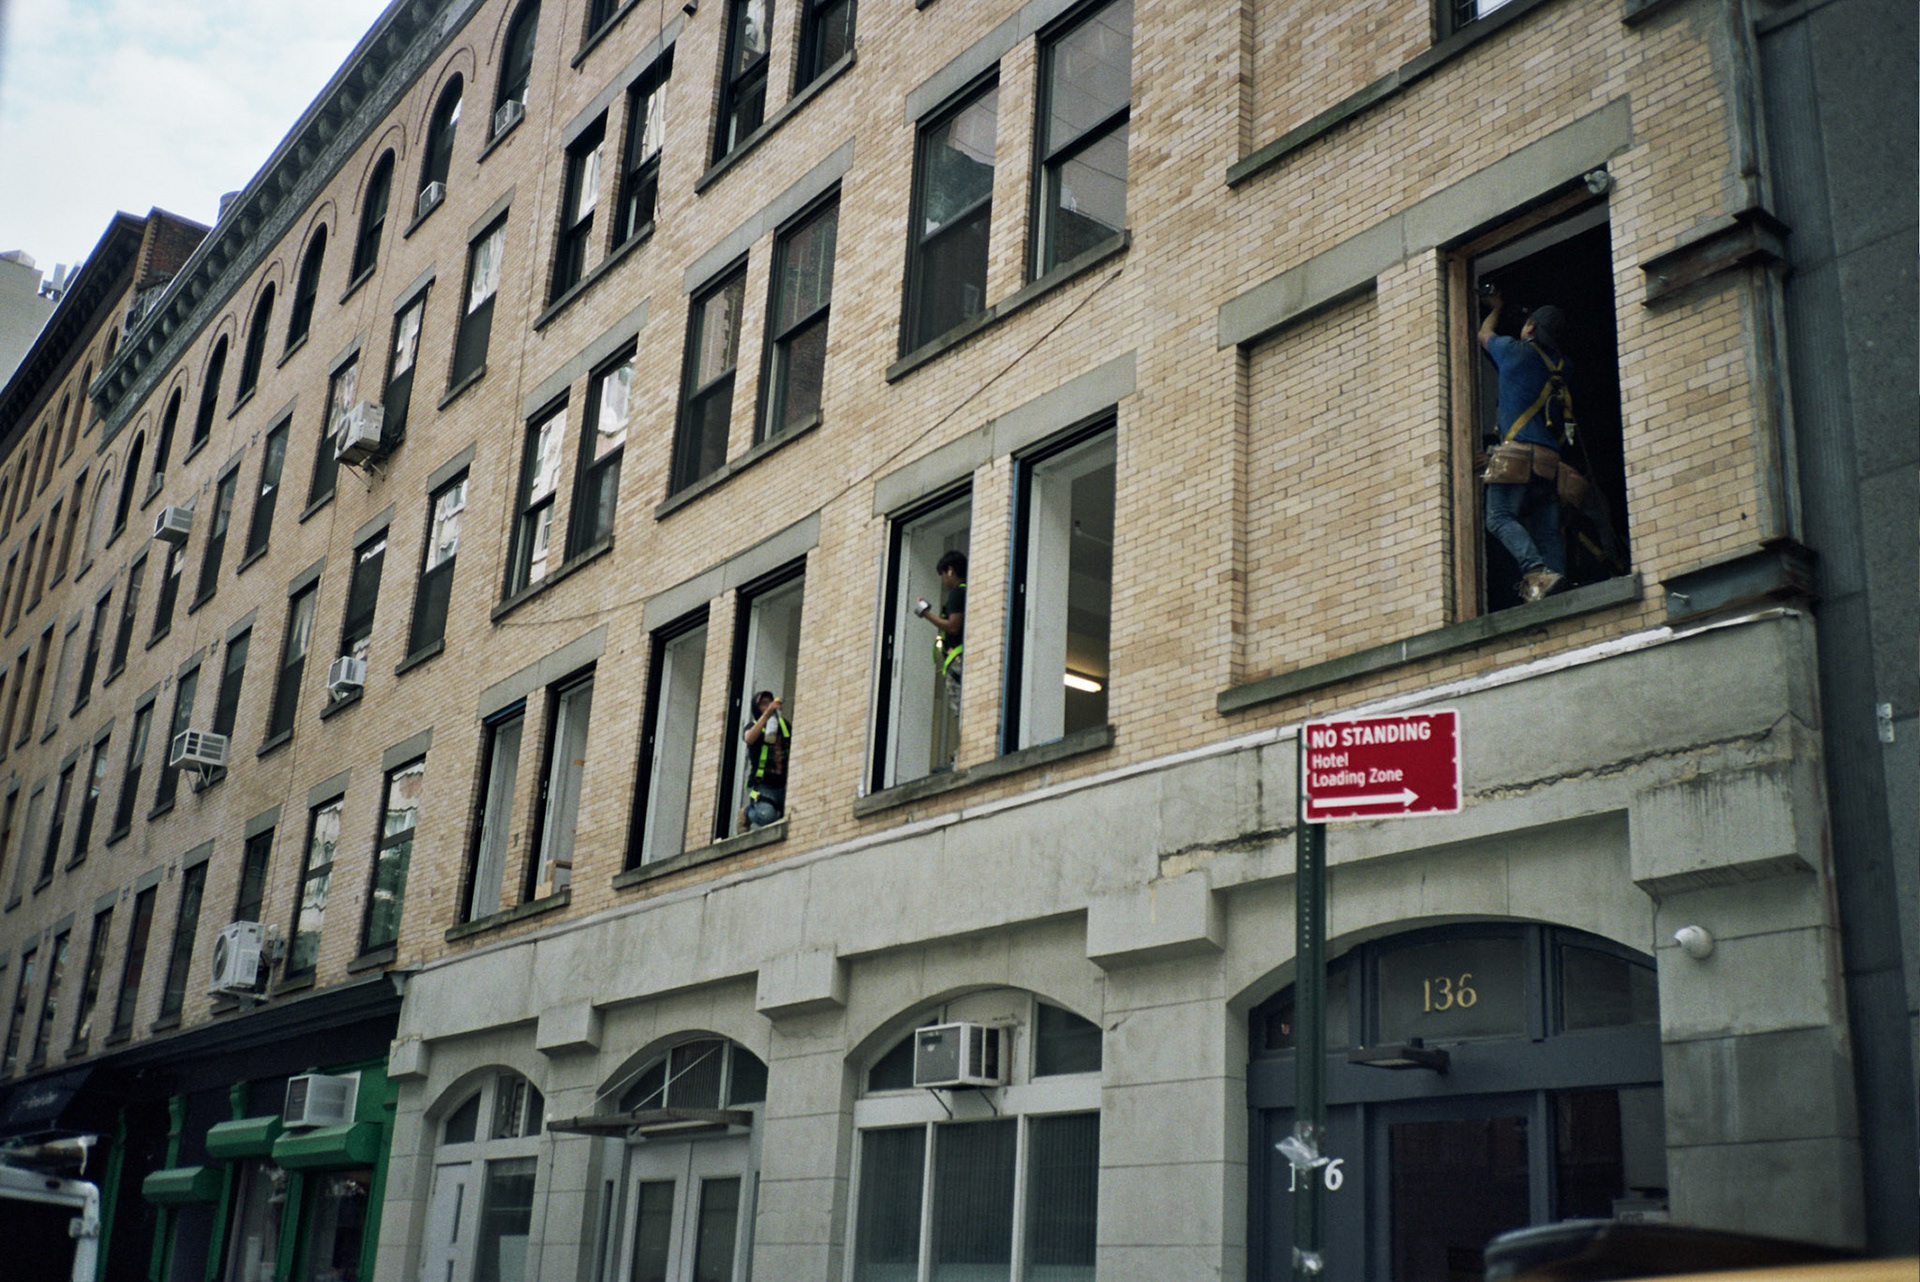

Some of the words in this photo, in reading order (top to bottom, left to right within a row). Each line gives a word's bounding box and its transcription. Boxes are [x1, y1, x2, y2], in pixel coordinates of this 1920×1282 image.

[1312, 730, 1338, 749] NO
[1342, 722, 1431, 747] STANDING
[1312, 752, 1349, 768] Hotel
[1312, 770, 1366, 788] Loading
[1369, 768, 1404, 783] Zone
[1424, 973, 1477, 1012] 136
[1288, 1158, 1344, 1192] 16
